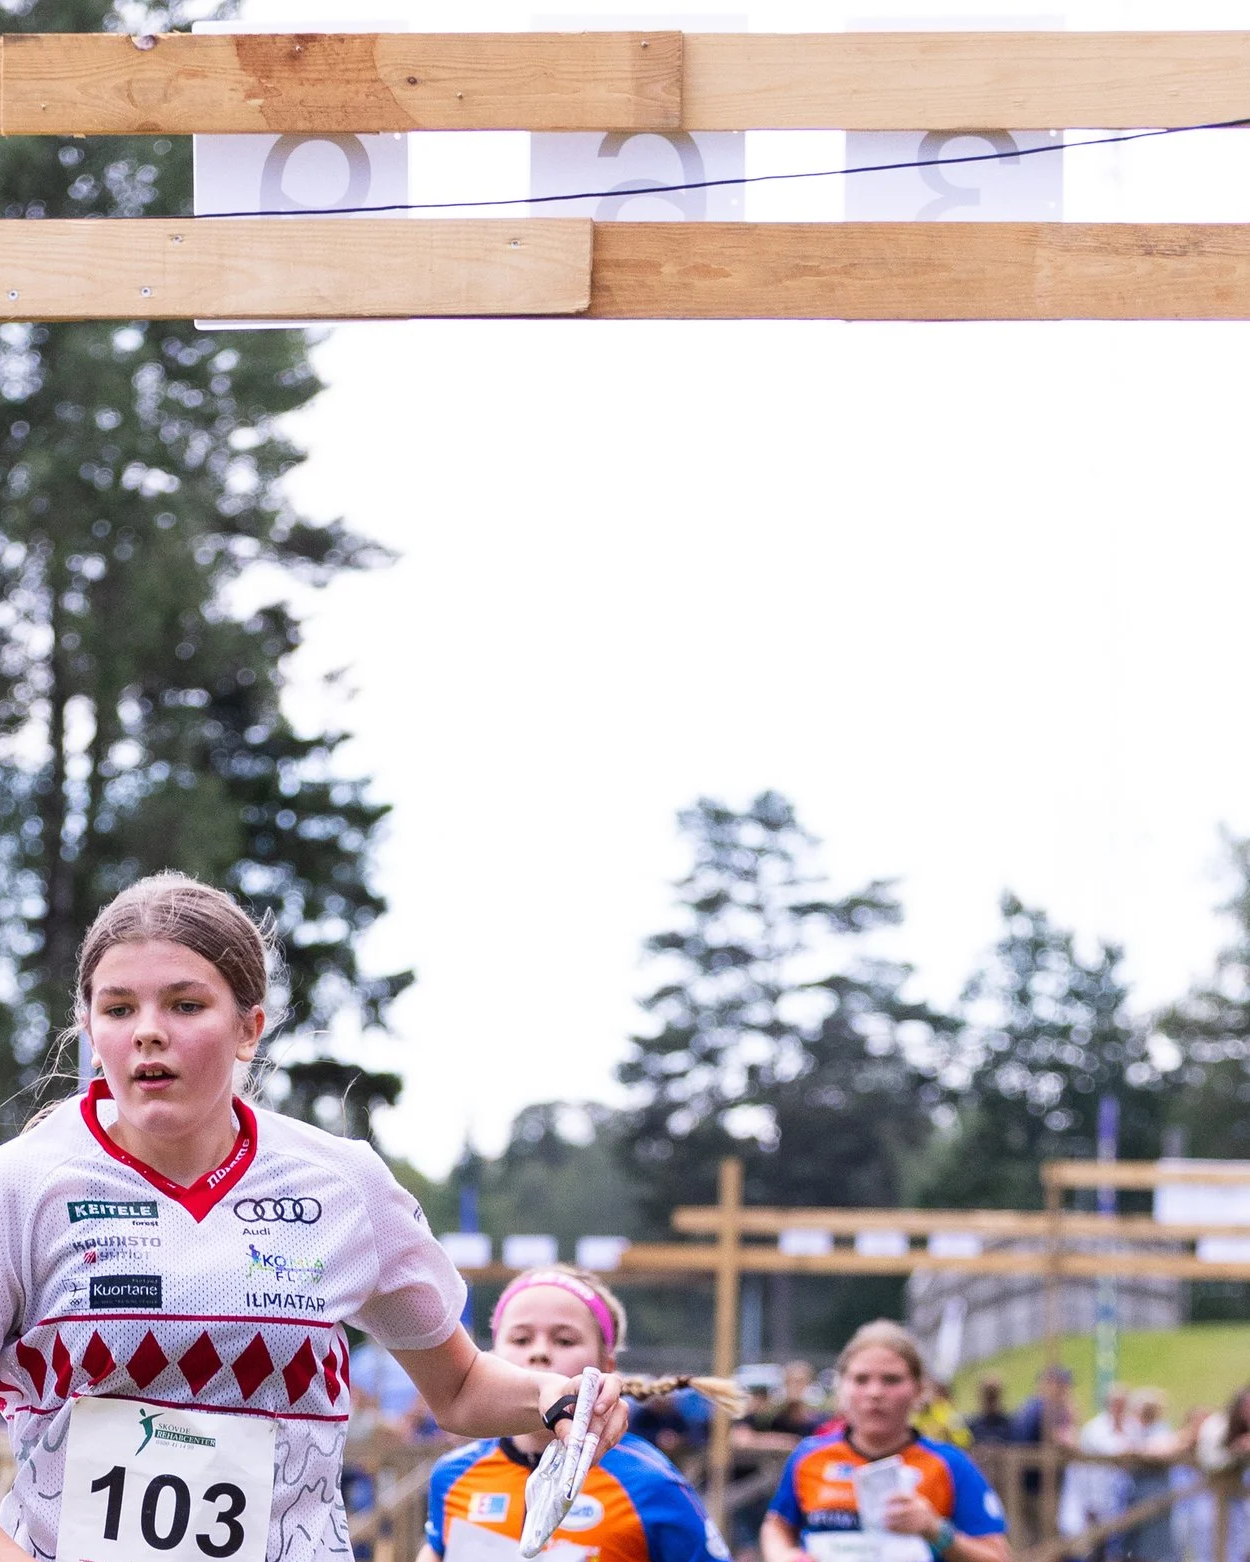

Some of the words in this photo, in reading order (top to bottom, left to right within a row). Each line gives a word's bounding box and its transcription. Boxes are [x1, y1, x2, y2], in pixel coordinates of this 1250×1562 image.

[74, 1203, 152, 1218] KEITELE
[242, 1227, 271, 1236] Audi
[93, 1284, 158, 1297] Kuortane
[246, 1291, 326, 1313] ILMATAR
[156, 1430, 216, 1447] REHABCENTER
[91, 1465, 247, 1559] 103
